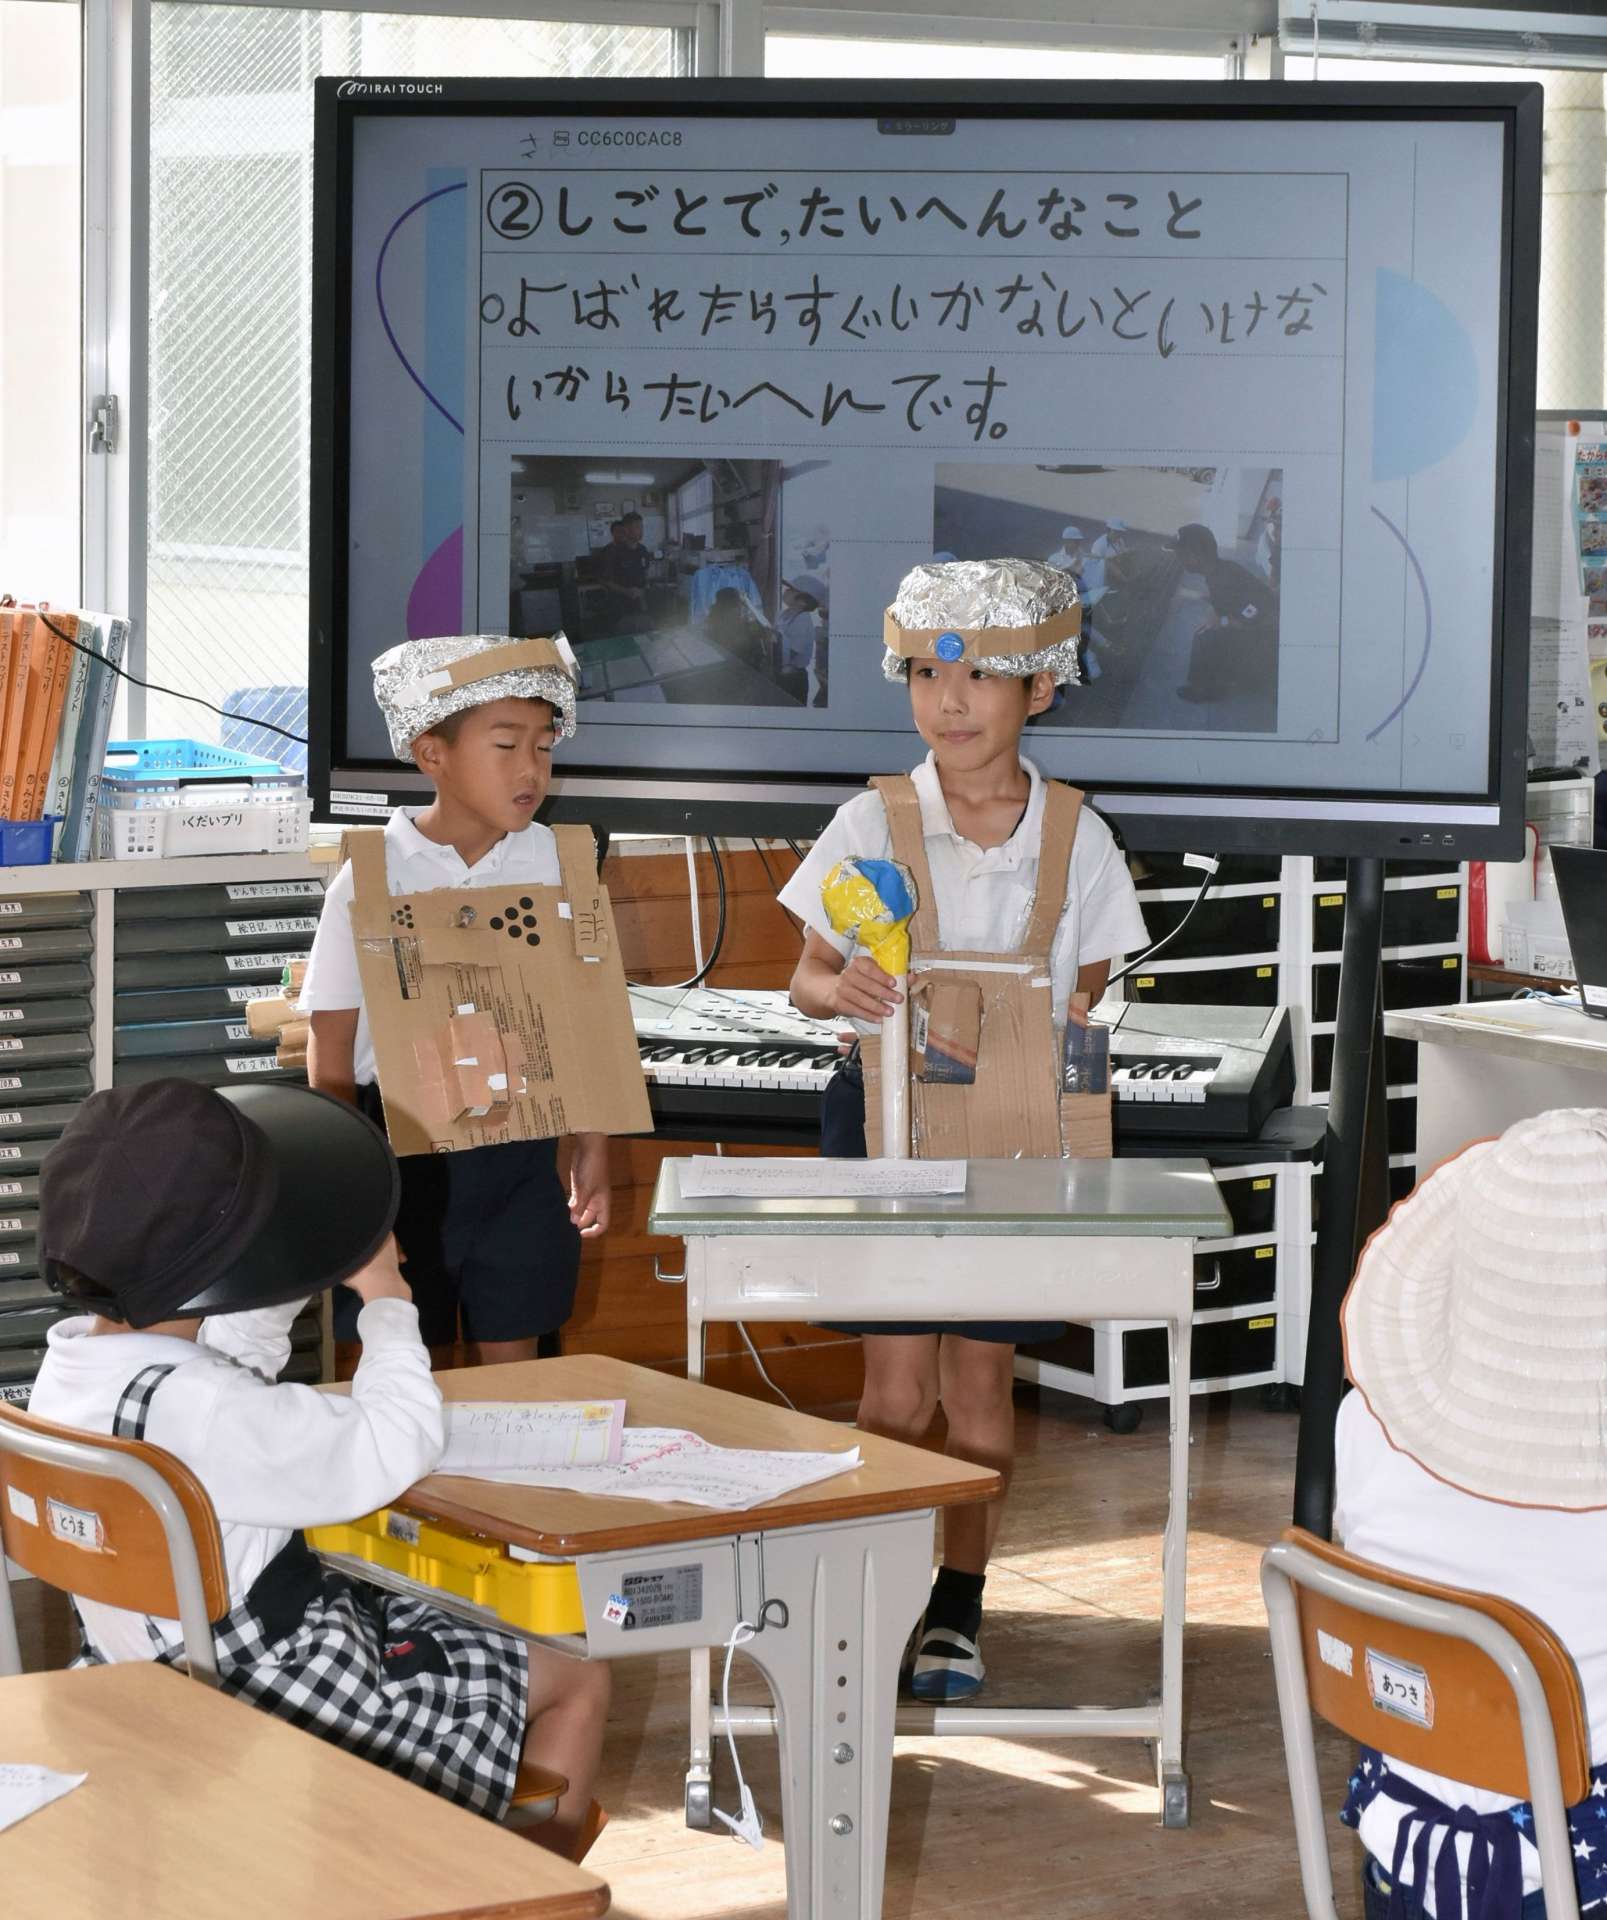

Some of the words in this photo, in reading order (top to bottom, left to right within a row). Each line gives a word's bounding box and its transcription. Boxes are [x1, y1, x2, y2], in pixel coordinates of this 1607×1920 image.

[400, 84, 443, 94] TOUCH
[577, 131, 683, 146] CC6C0CAC8
[1382, 1673, 1418, 1706] あつき
